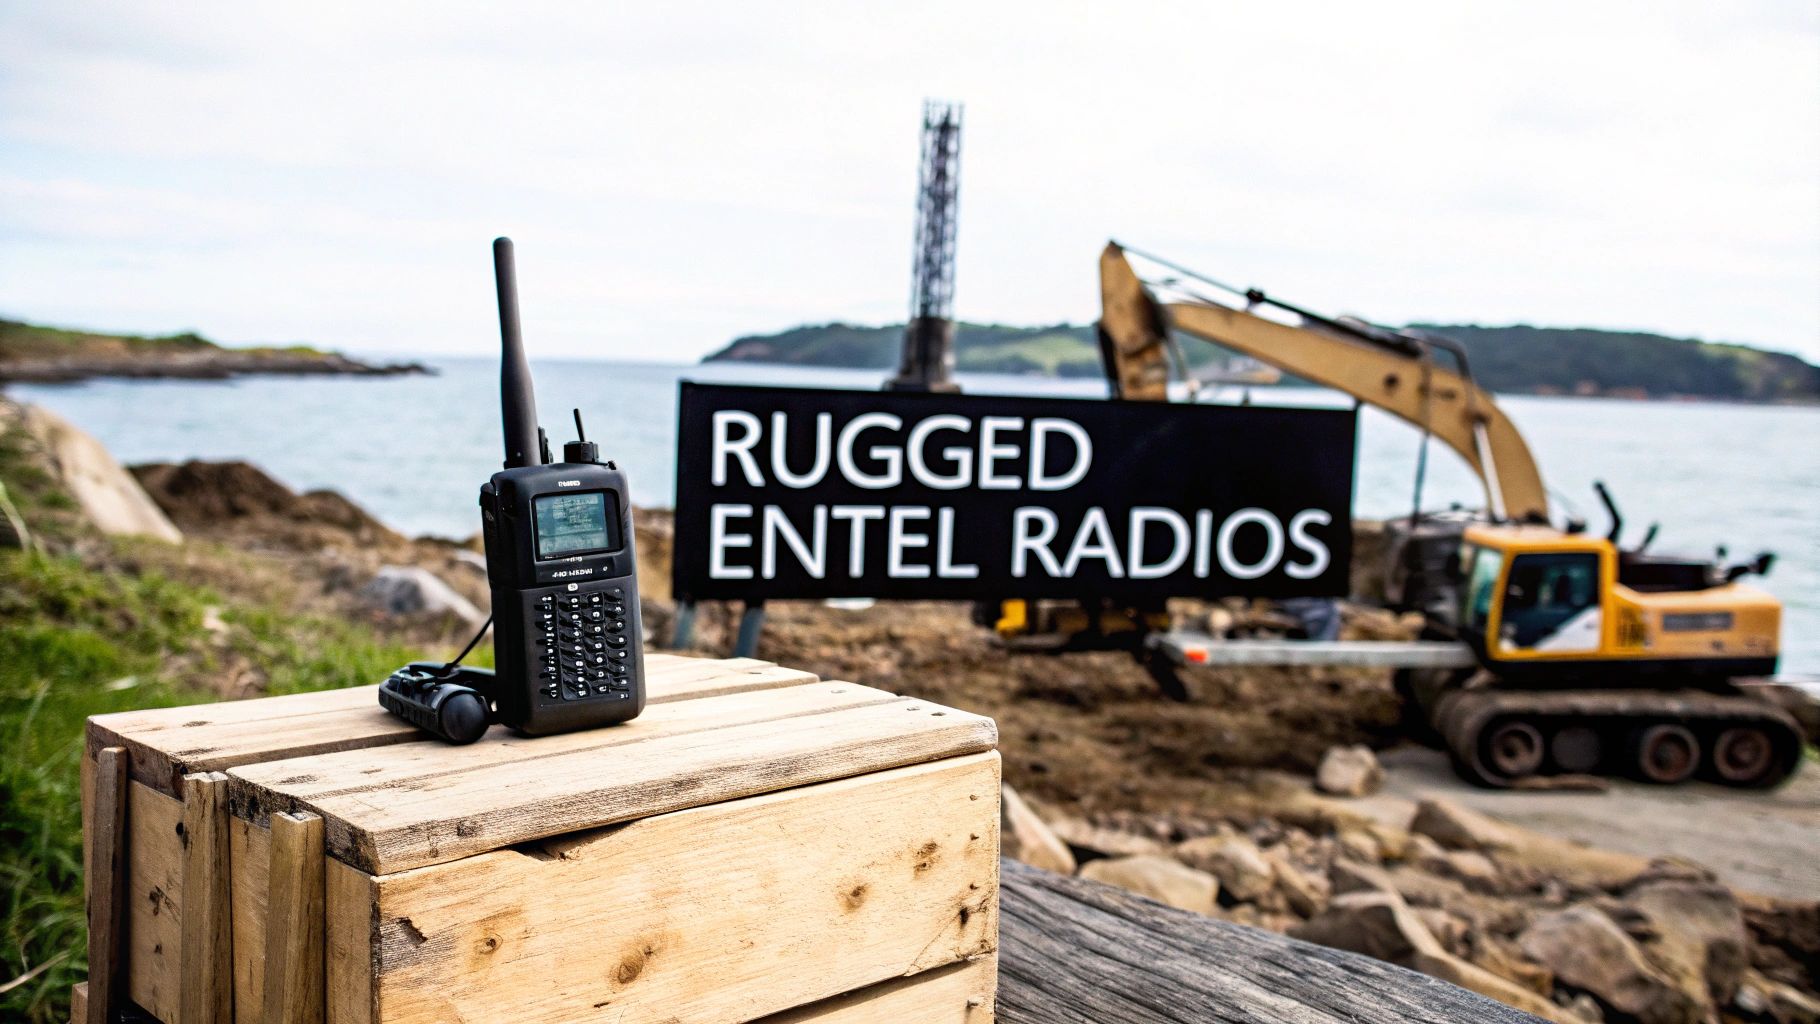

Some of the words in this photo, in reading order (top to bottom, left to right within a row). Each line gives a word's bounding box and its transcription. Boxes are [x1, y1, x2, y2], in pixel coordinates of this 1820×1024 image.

[710, 410, 1093, 491] RUGGED
[709, 503, 980, 580] ENTEL
[1011, 506, 1332, 580] RADIOS
